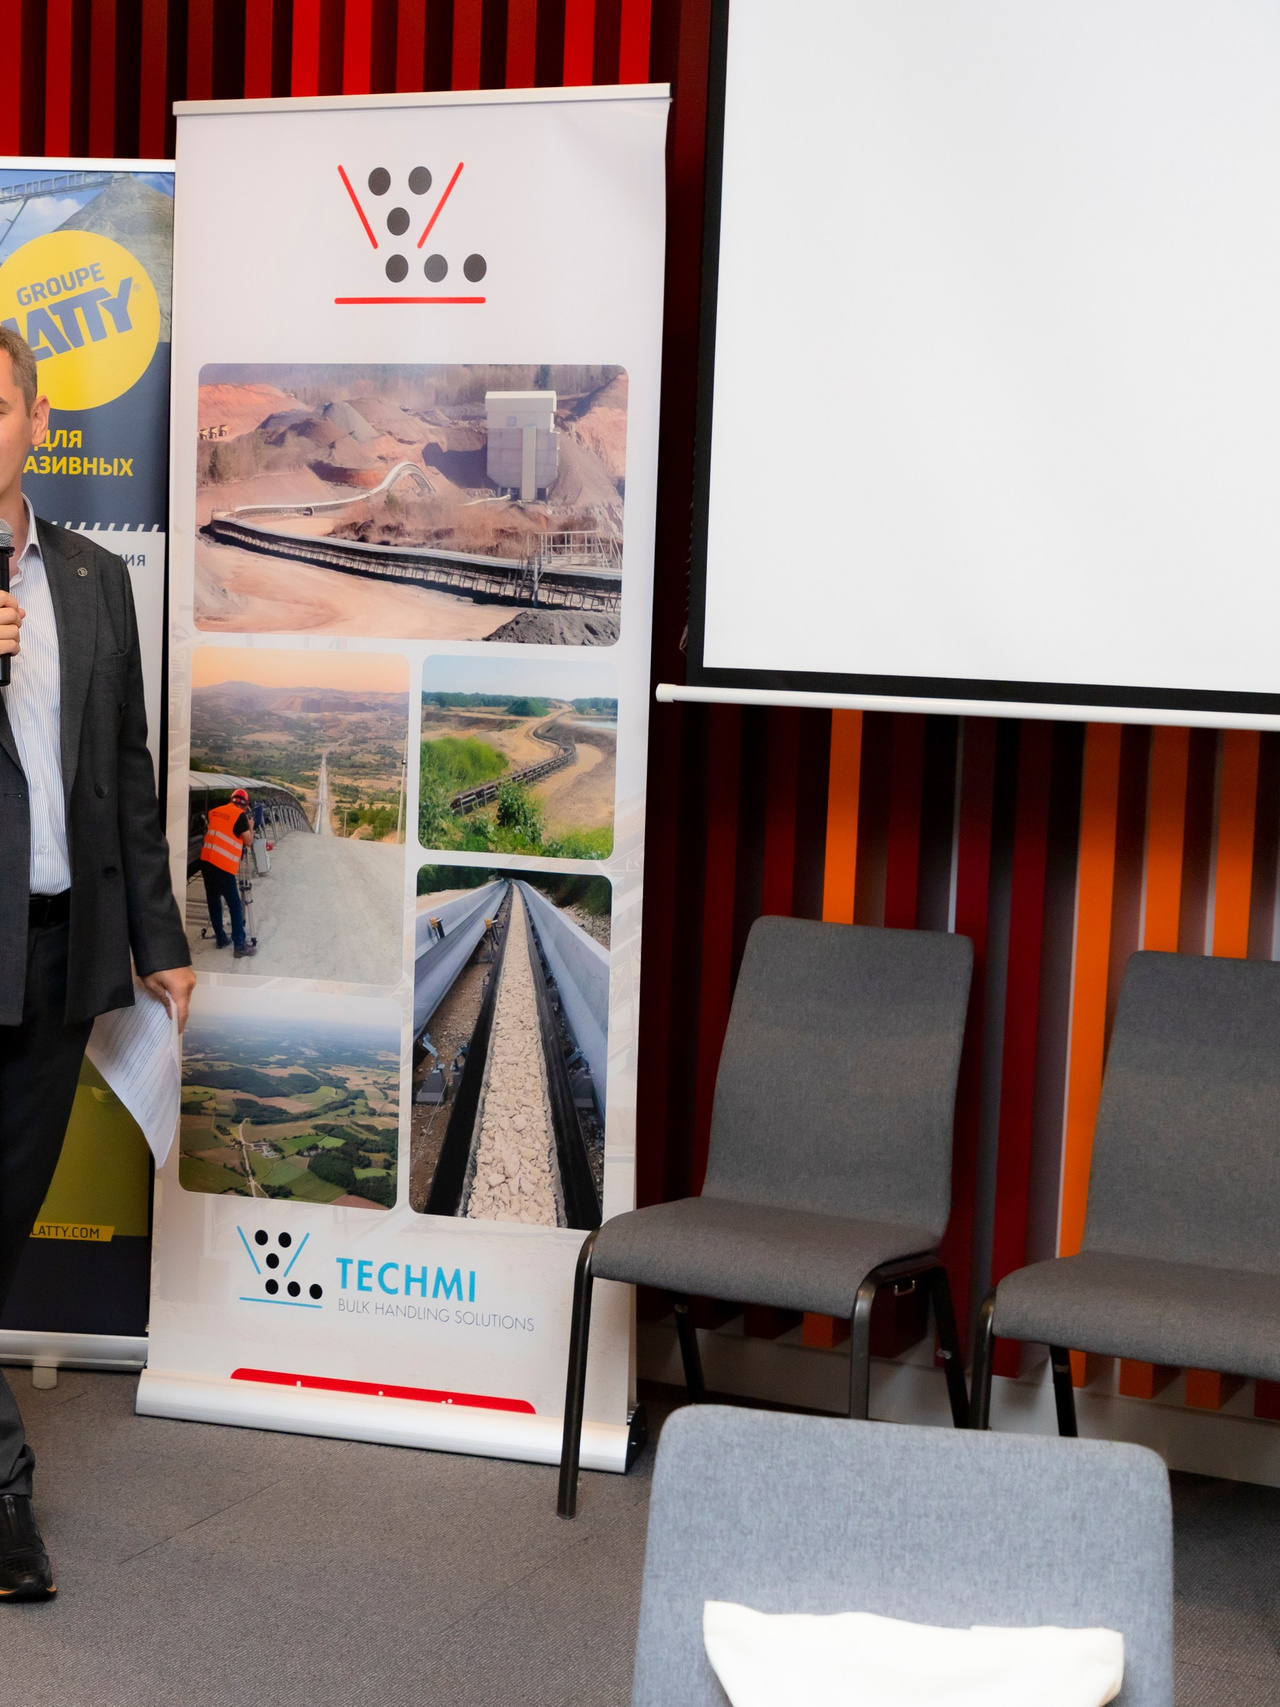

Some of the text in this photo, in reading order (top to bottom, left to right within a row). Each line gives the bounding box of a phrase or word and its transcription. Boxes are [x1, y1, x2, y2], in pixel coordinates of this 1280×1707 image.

[16, 262, 105, 306] GROUPE
[22, 456, 134, 477] АЗИВНЫХ
[336, 1257, 476, 1303] TECHMI
[338, 1298, 535, 1332] BULK HANDLING SOLUTIONS
